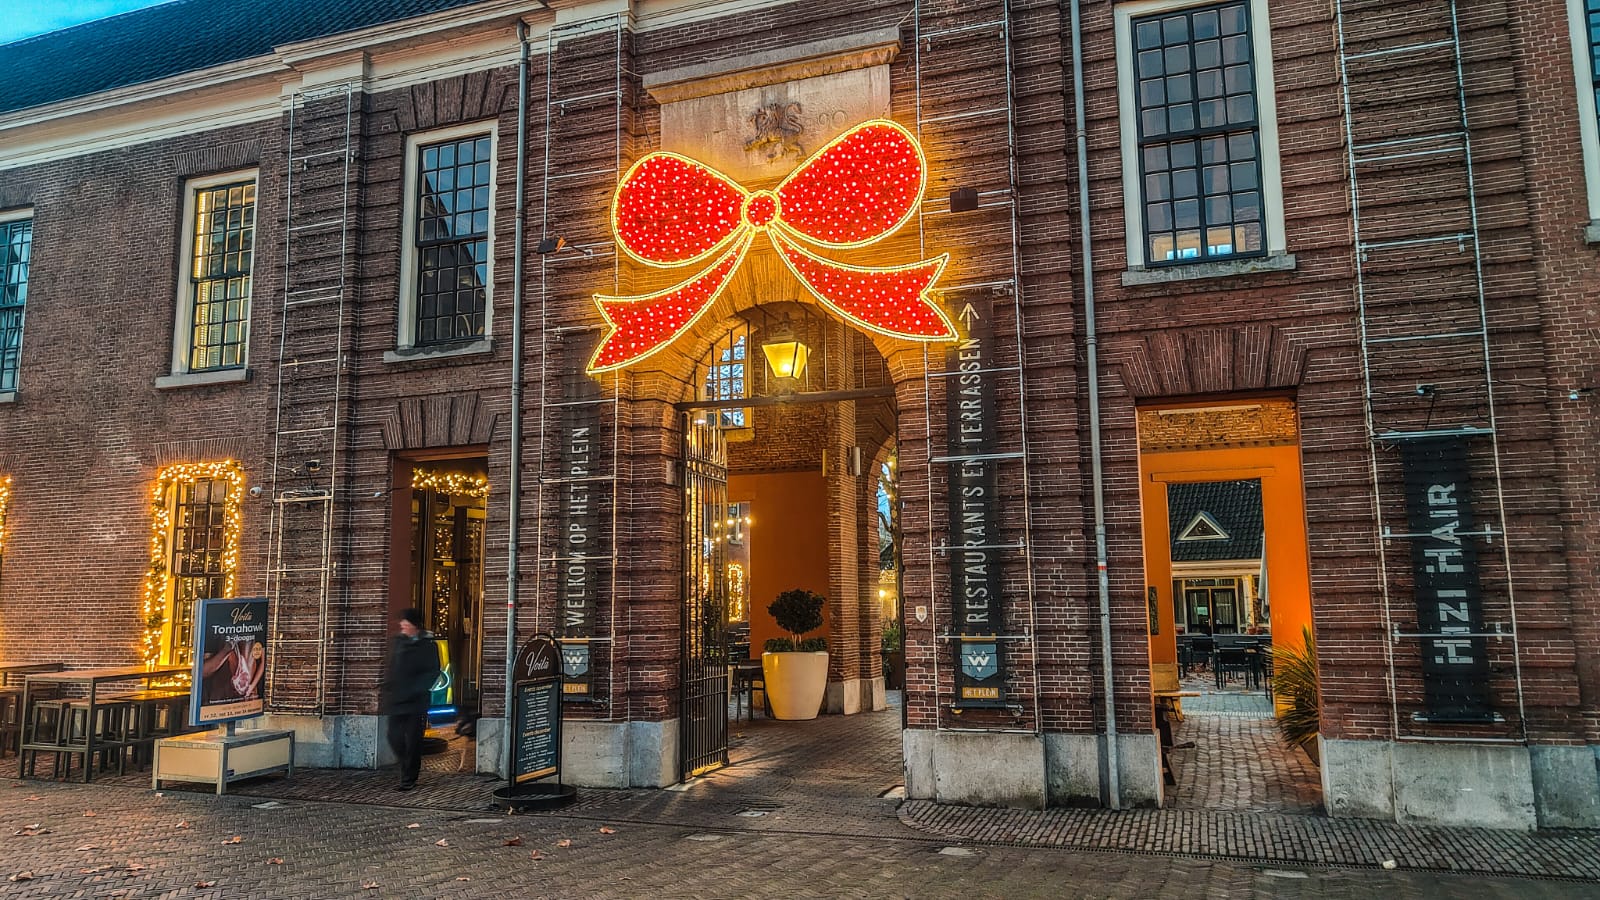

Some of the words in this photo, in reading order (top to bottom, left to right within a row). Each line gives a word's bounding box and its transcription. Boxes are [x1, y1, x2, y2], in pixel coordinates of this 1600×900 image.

[958, 338, 983, 443] TERRASSEN
[570, 427, 590, 475] PLEIN
[961, 455, 984, 478] EN
[569, 483, 589, 515] HET
[569, 523, 587, 544] OP
[1424, 482, 1464, 573] HAIR
[962, 486, 989, 623] RESTAURANTS
[566, 551, 587, 627] WELKOM
[211, 622, 264, 635] Tomahawk
[1433, 589, 1474, 664] HIZI
[978, 687, 996, 697] PLEIN
